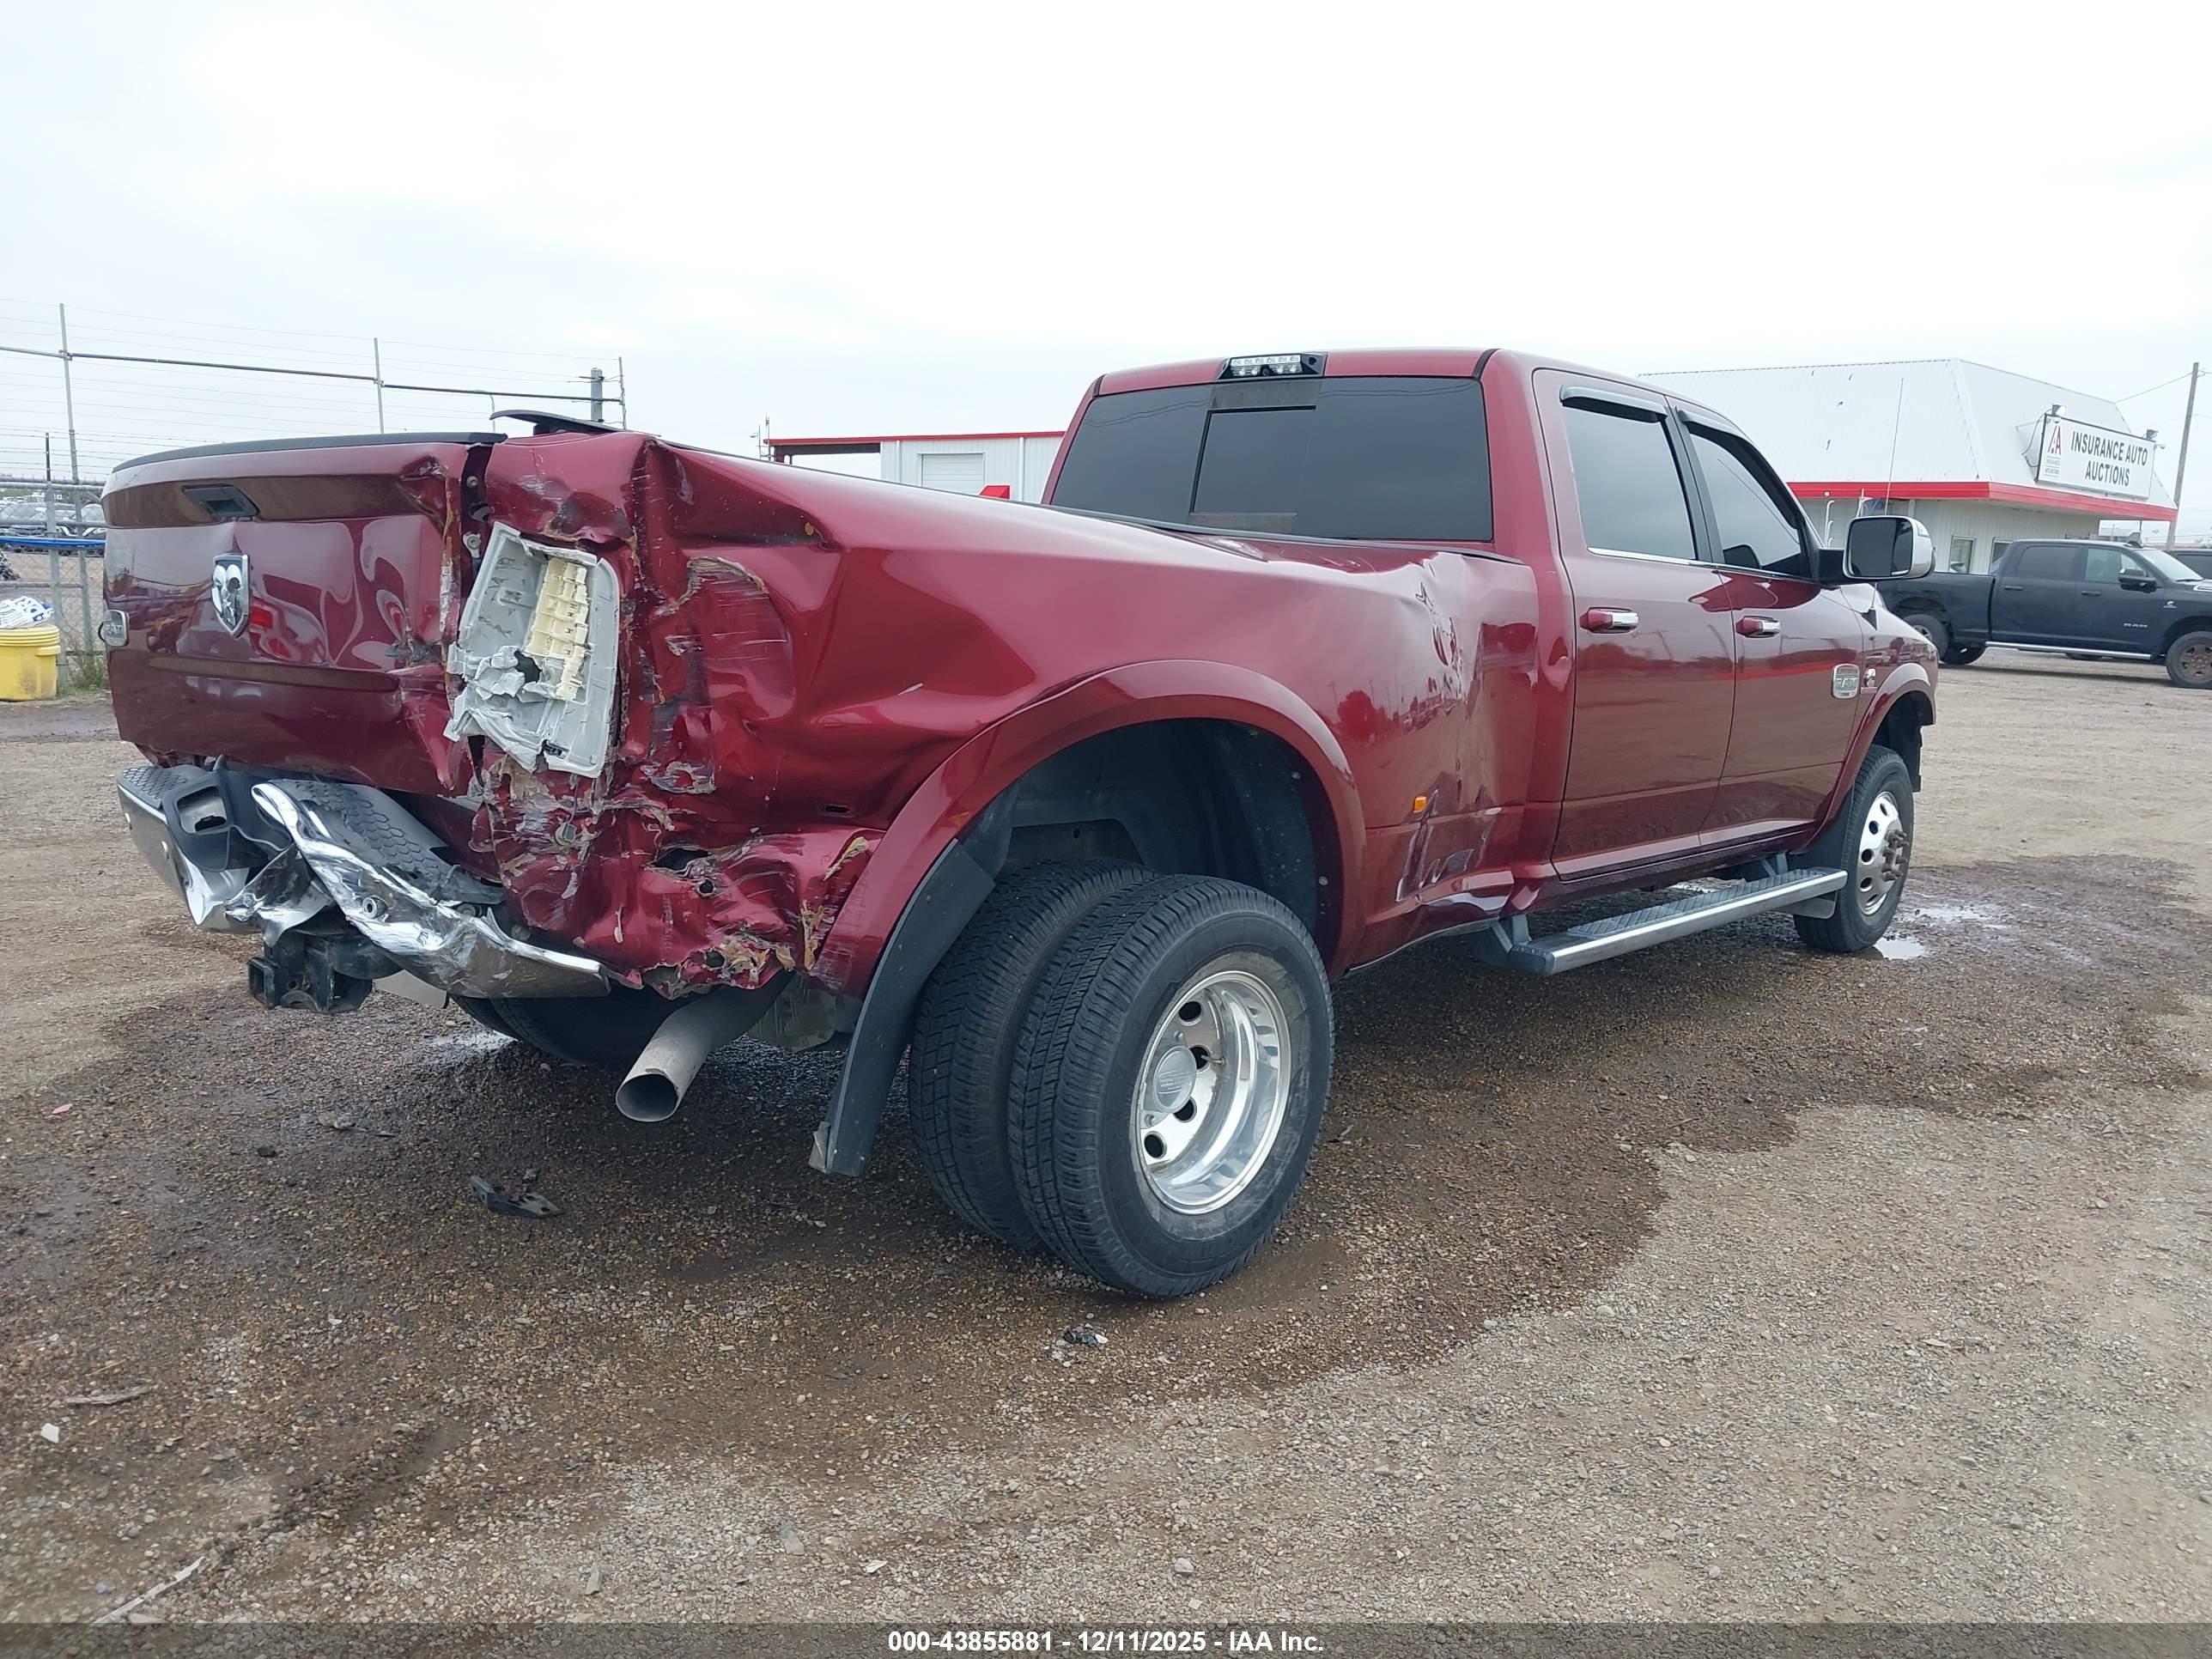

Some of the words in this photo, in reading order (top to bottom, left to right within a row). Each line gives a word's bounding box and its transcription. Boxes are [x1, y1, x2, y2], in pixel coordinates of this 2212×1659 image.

[2070, 430, 2125, 461] INSURANCE
[2124, 444, 2148, 466] AUTO
[2085, 460, 2130, 487] AUCTIONS
